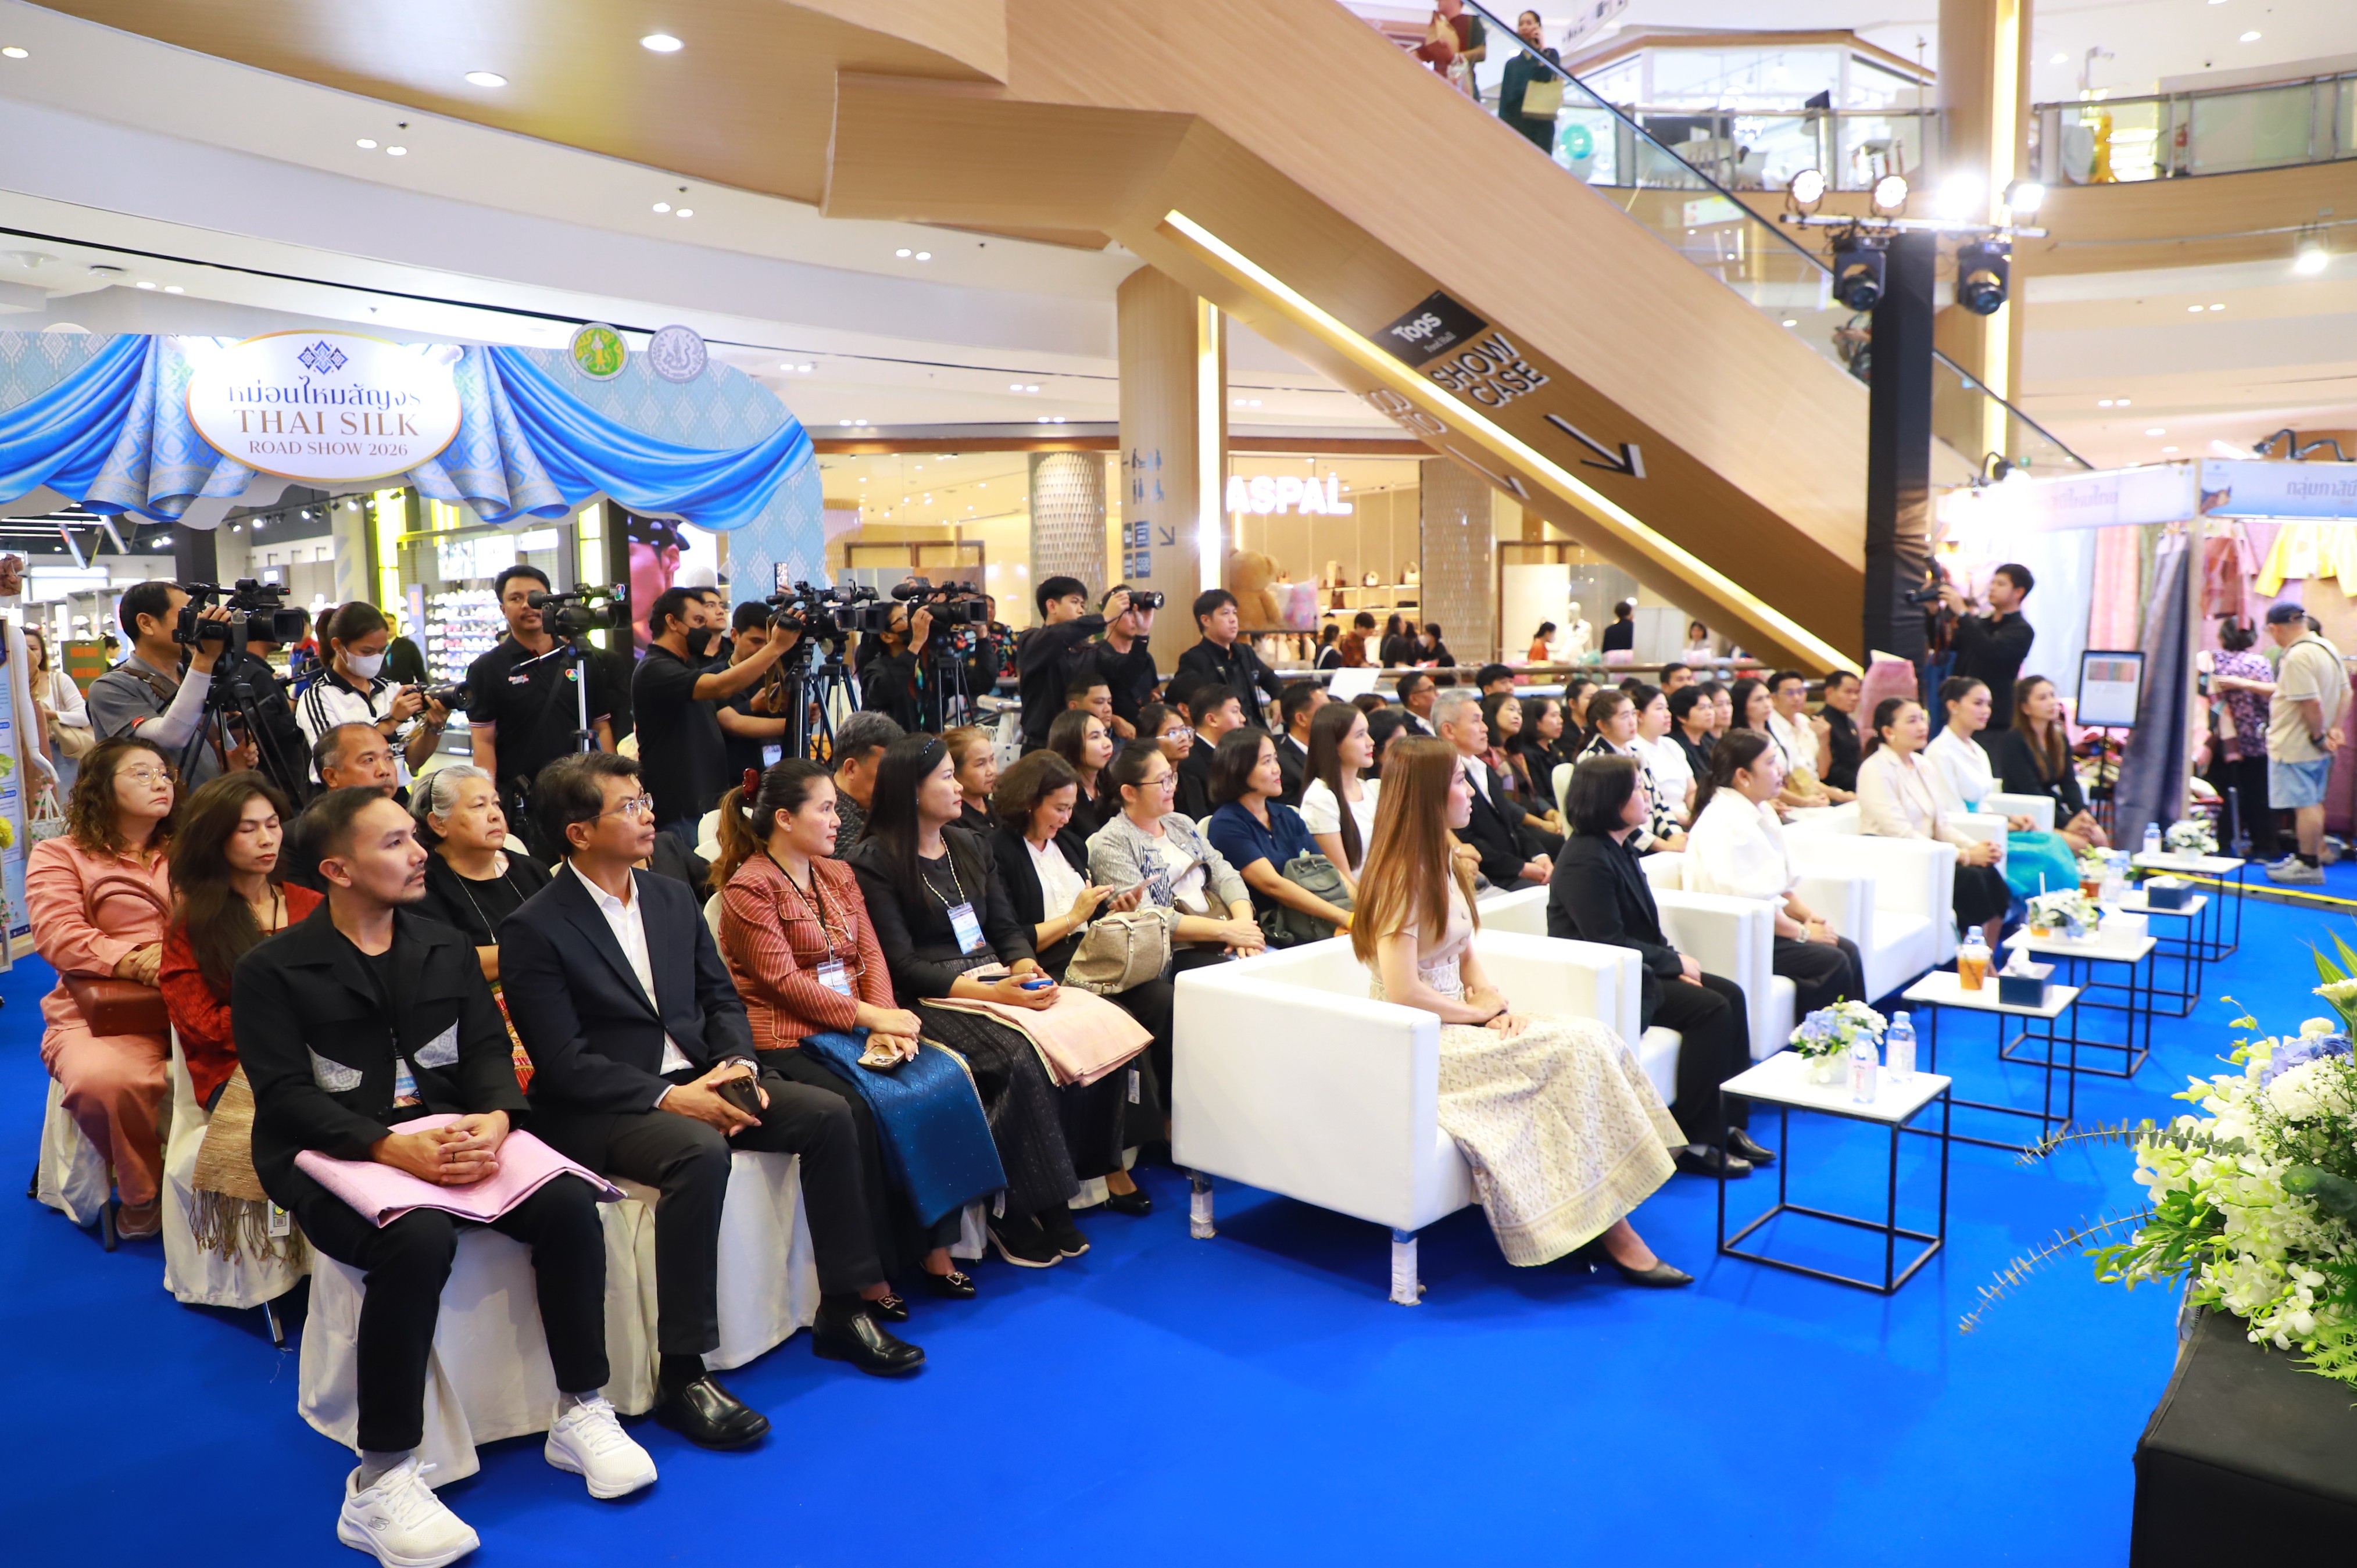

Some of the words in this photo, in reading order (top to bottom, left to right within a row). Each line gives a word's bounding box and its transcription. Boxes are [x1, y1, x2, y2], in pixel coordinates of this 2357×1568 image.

[1390, 312, 1442, 343] Tops
[1430, 332, 1520, 391] SHOW
[1469, 360, 1550, 407] CASE
[233, 409, 326, 435] THAI
[341, 411, 420, 436] SILK
[249, 441, 302, 455] ROAD
[307, 442, 363, 456] SHOW
[369, 443, 407, 456] 2026
